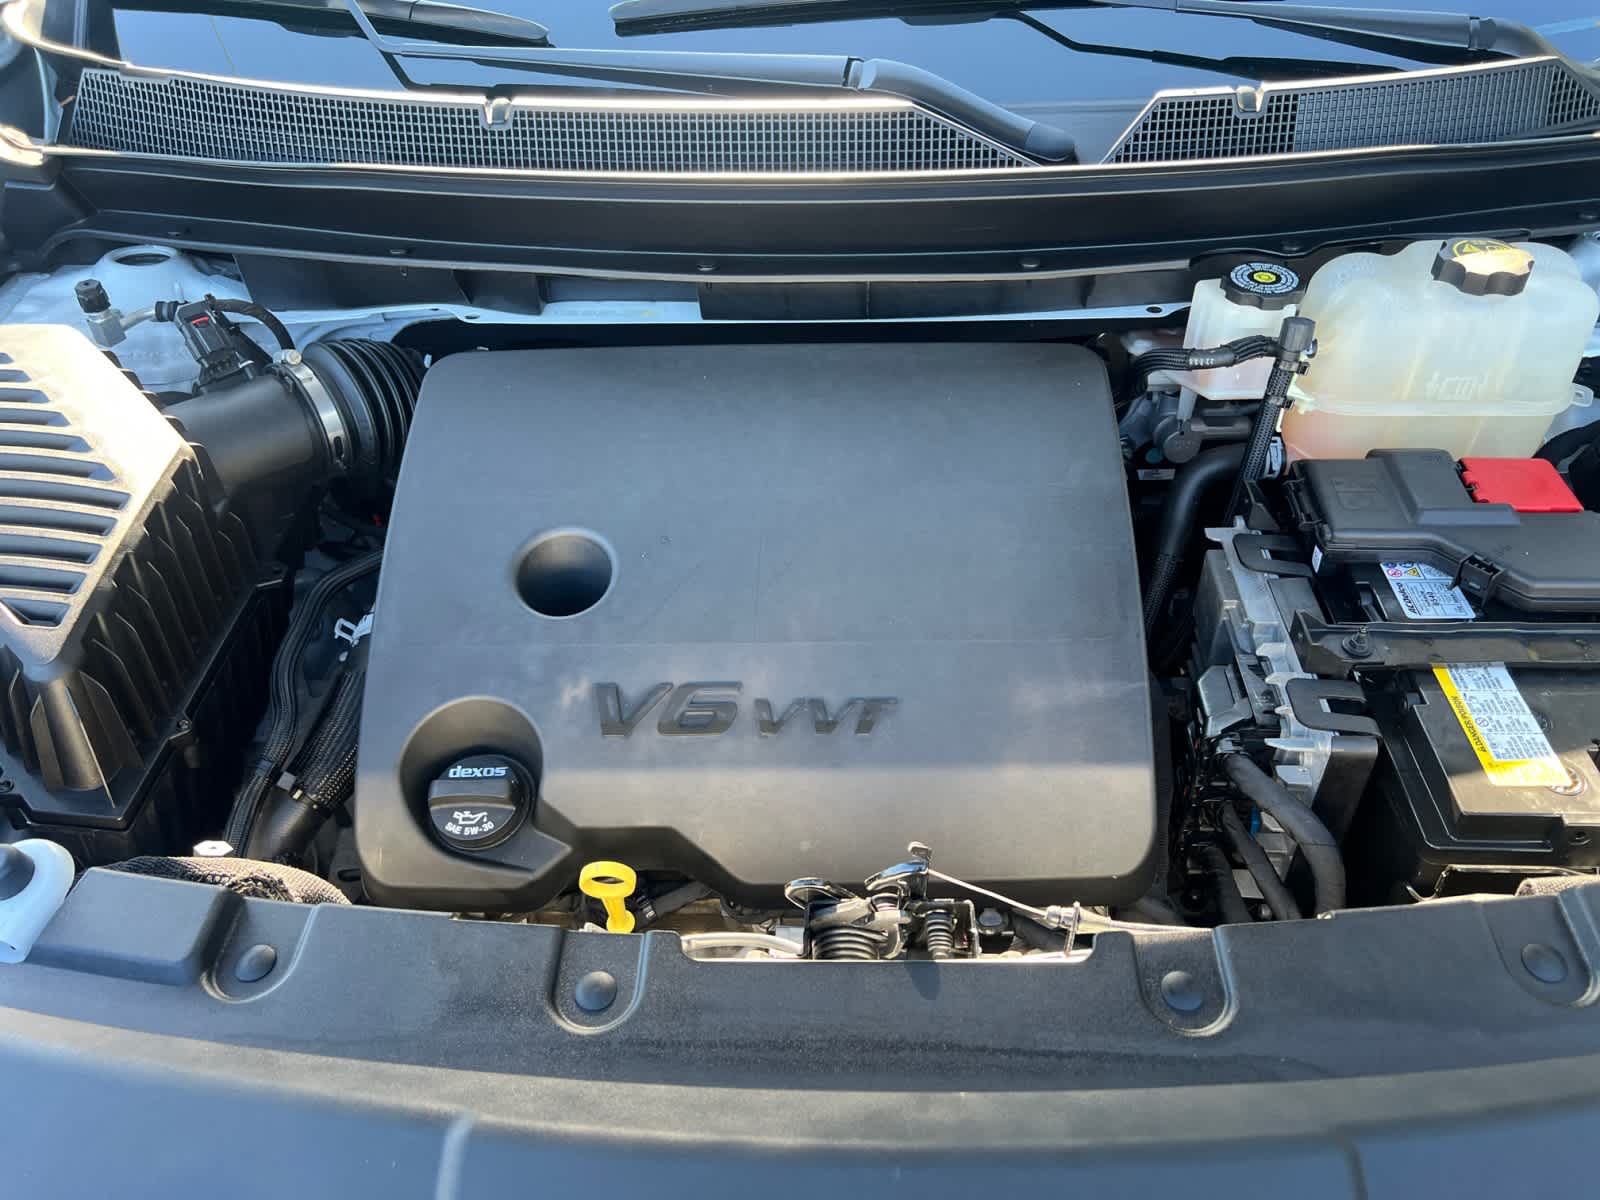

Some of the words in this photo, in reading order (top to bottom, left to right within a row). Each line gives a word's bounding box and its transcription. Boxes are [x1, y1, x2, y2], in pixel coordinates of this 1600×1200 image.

[592, 681, 743, 737] V6
[753, 696, 898, 734] VVT
[448, 765, 509, 778] dexos
[444, 821, 463, 835] SAE
[463, 820, 495, 836] 5W-30
